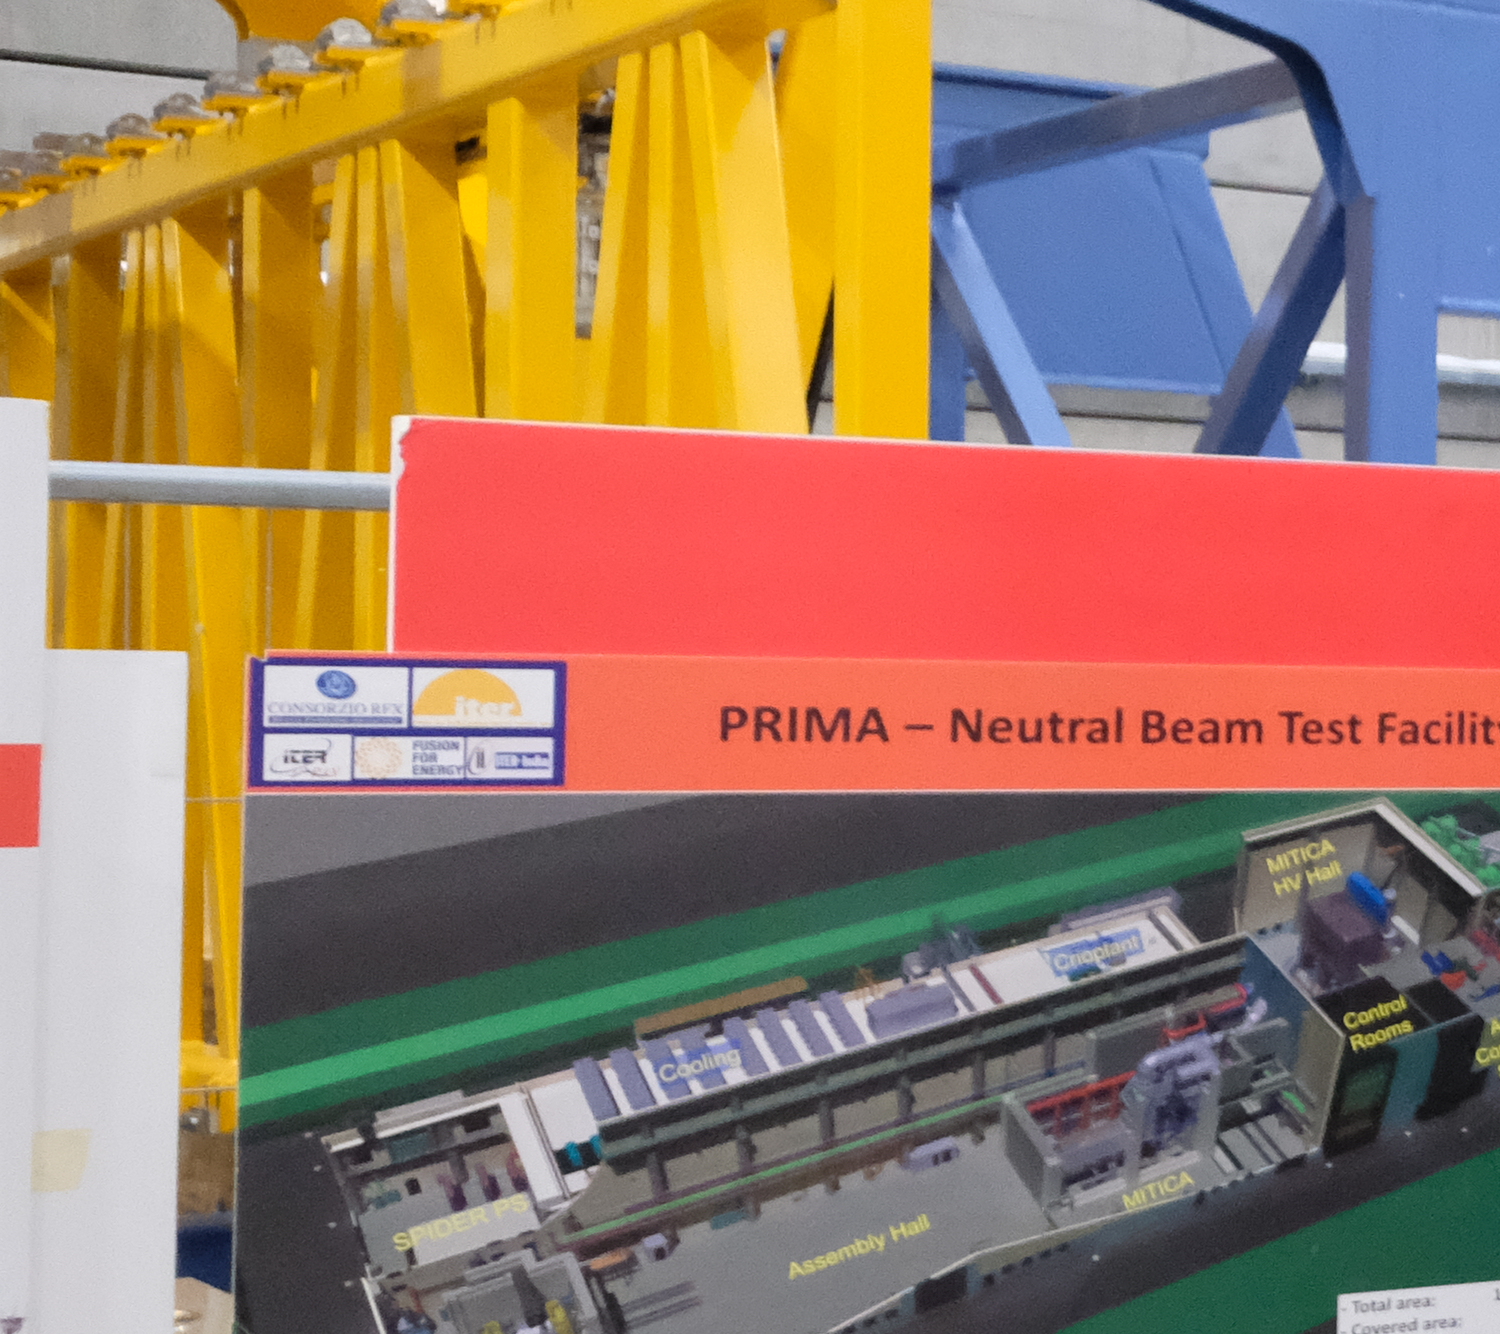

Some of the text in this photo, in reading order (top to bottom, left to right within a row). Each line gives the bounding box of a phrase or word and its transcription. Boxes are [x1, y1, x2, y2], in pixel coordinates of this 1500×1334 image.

[268, 702, 367, 715] CONSORZIO
[720, 705, 889, 743] PRIMA
[950, 707, 1124, 744] Neutral
[1141, 709, 1264, 745] Beam
[1278, 710, 1362, 745] Test
[412, 739, 460, 751] FUSION
[412, 751, 438, 763] FOR
[412, 764, 464, 776] ENERGY
[1266, 839, 1336, 875] MITICA
[1273, 860, 1344, 896] HV Hall
[1052, 932, 1142, 971] Crioplant
[1343, 994, 1409, 1030] Control
[1350, 1020, 1415, 1054] Rooms
[657, 1047, 743, 1084] Cooling
[1122, 1171, 1196, 1212] MITICA
[391, 1192, 531, 1253] SPIDER PS
[786, 1213, 932, 1280] Assembly Hall
[1352, 1298, 1391, 1315] Total
[1396, 1297, 1435, 1311] area:
[1422, 1317, 1463, 1331] area:
